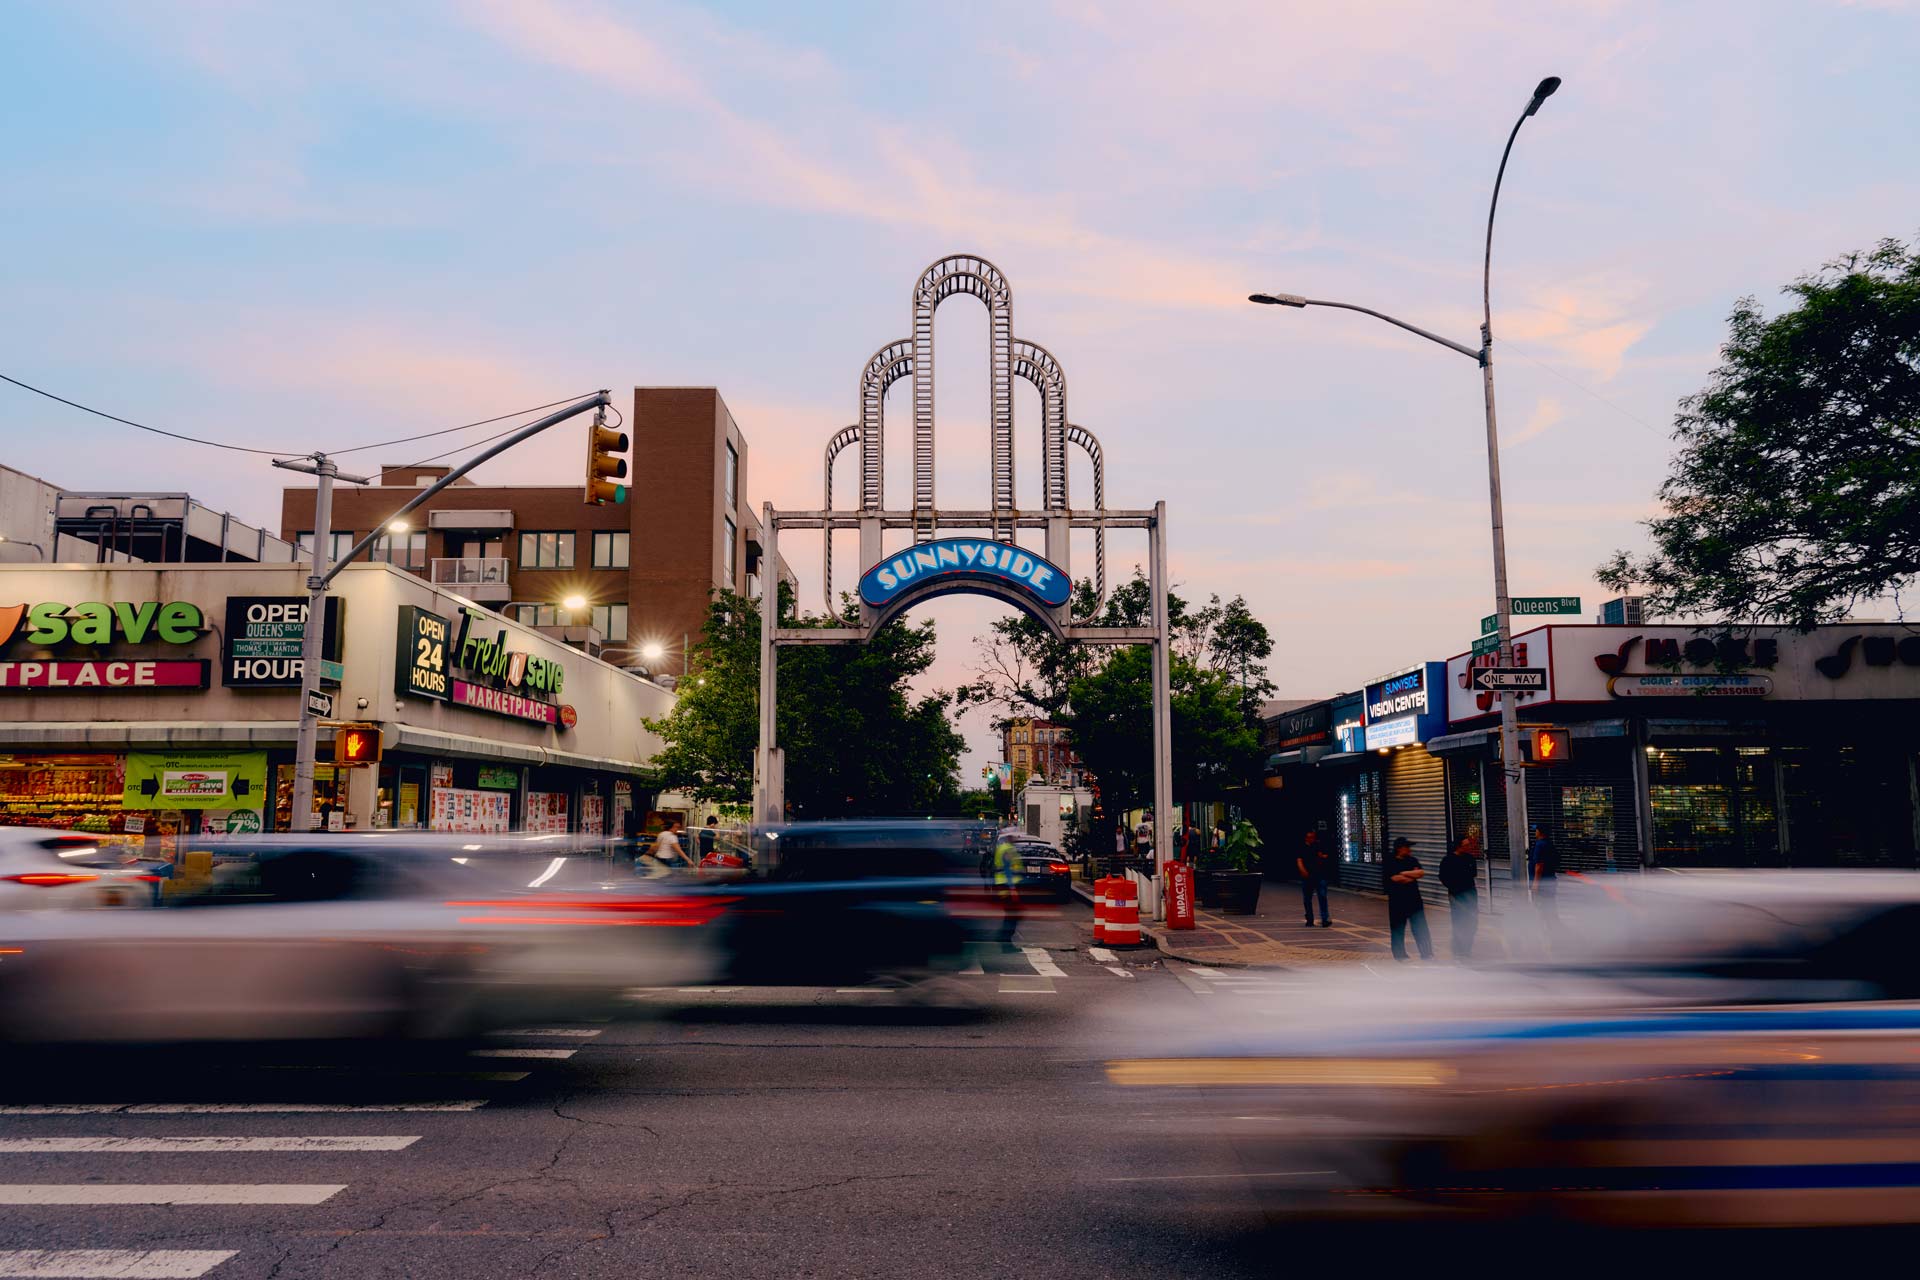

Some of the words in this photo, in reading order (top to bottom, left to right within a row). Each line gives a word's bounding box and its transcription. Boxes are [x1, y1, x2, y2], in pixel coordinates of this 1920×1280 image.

[877, 543, 1054, 591] SUNNYSIDE
[1514, 600, 1559, 614] Queens
[1561, 599, 1577, 607] Blvd
[27, 601, 201, 645] save
[247, 623, 284, 638] QUEENS
[285, 624, 303, 632] BLVD
[419, 616, 445, 642] OPEN
[1485, 618, 1492, 631] 46
[417, 637, 443, 672] 24
[460, 608, 509, 681] Fresh
[525, 654, 564, 694] save
[233, 659, 304, 679] HOUR
[1484, 675, 1504, 684] ONE
[1514, 674, 1536, 684] WAY
[412, 667, 445, 693] HOURS
[1385, 674, 1419, 695] SUNNYSIDE
[465, 683, 547, 722] MARKETPLACE
[1369, 697, 1395, 718] VISION
[1289, 713, 1314, 734] Sofra
[229, 819, 259, 834] 7%
[1175, 873, 1187, 918] IMPACTO
